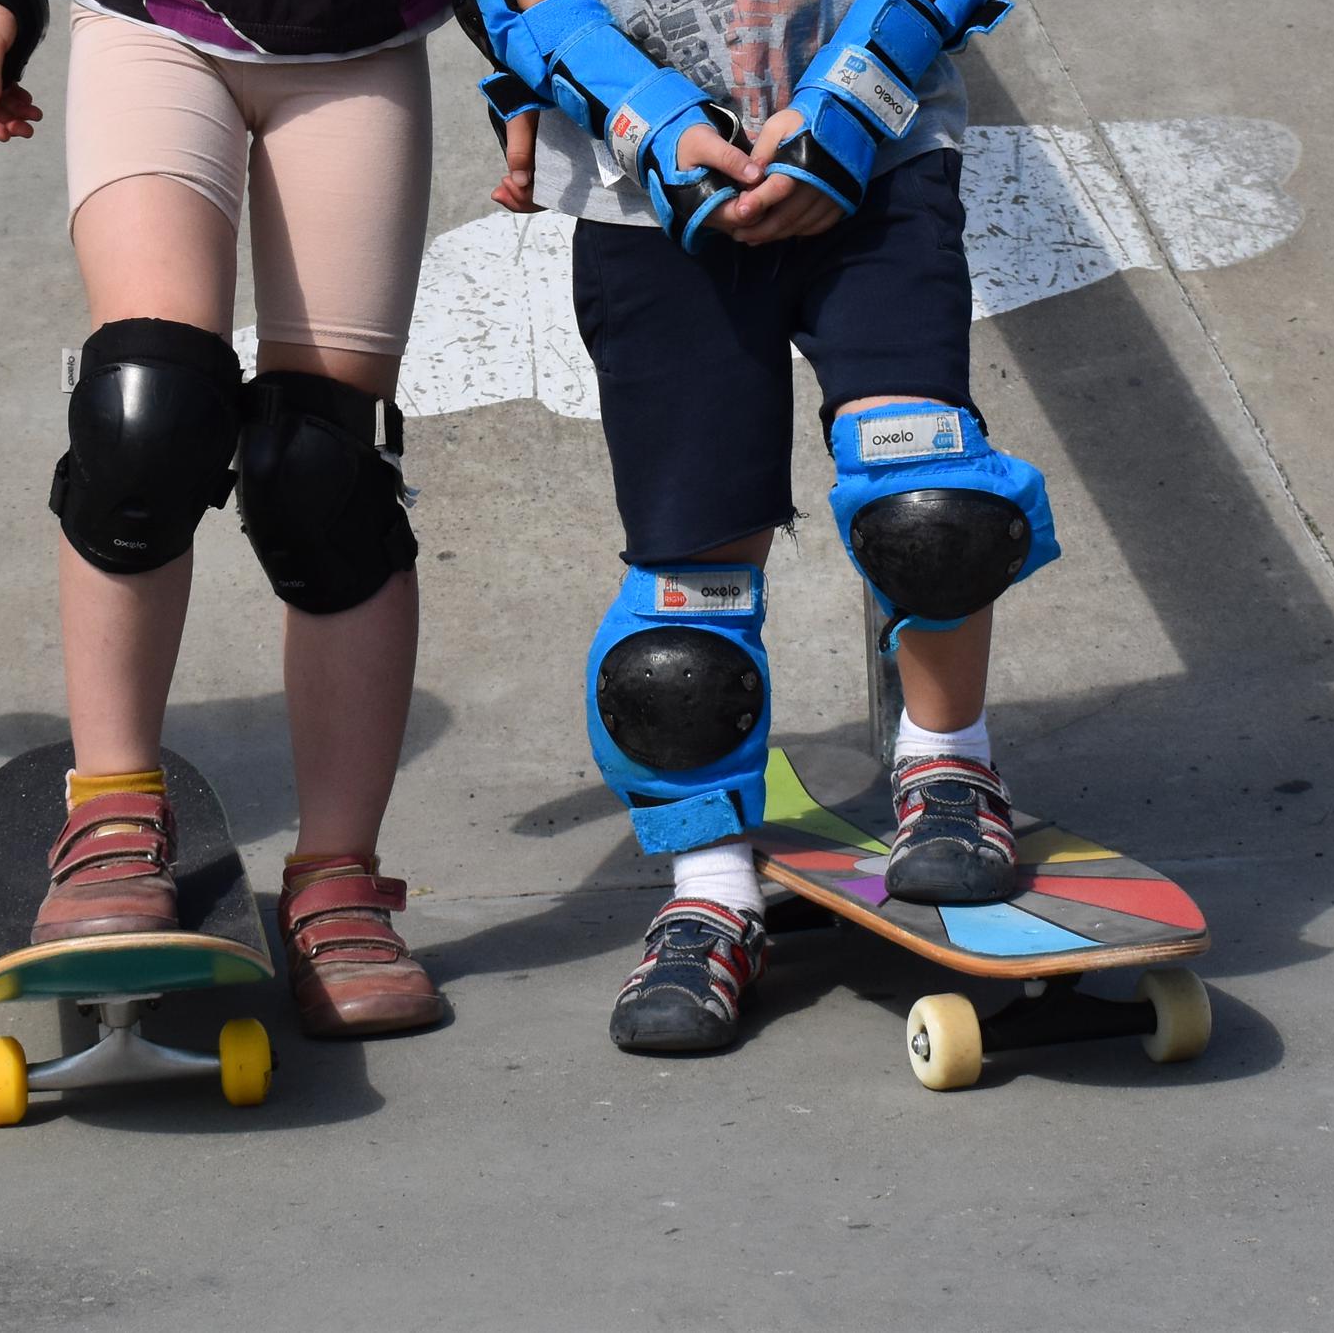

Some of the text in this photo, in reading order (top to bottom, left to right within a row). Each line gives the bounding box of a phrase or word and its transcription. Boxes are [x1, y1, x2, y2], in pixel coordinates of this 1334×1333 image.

[874, 85, 904, 115] oxelo
[872, 430, 914, 446] oxelo
[701, 584, 741, 597] oxelo
